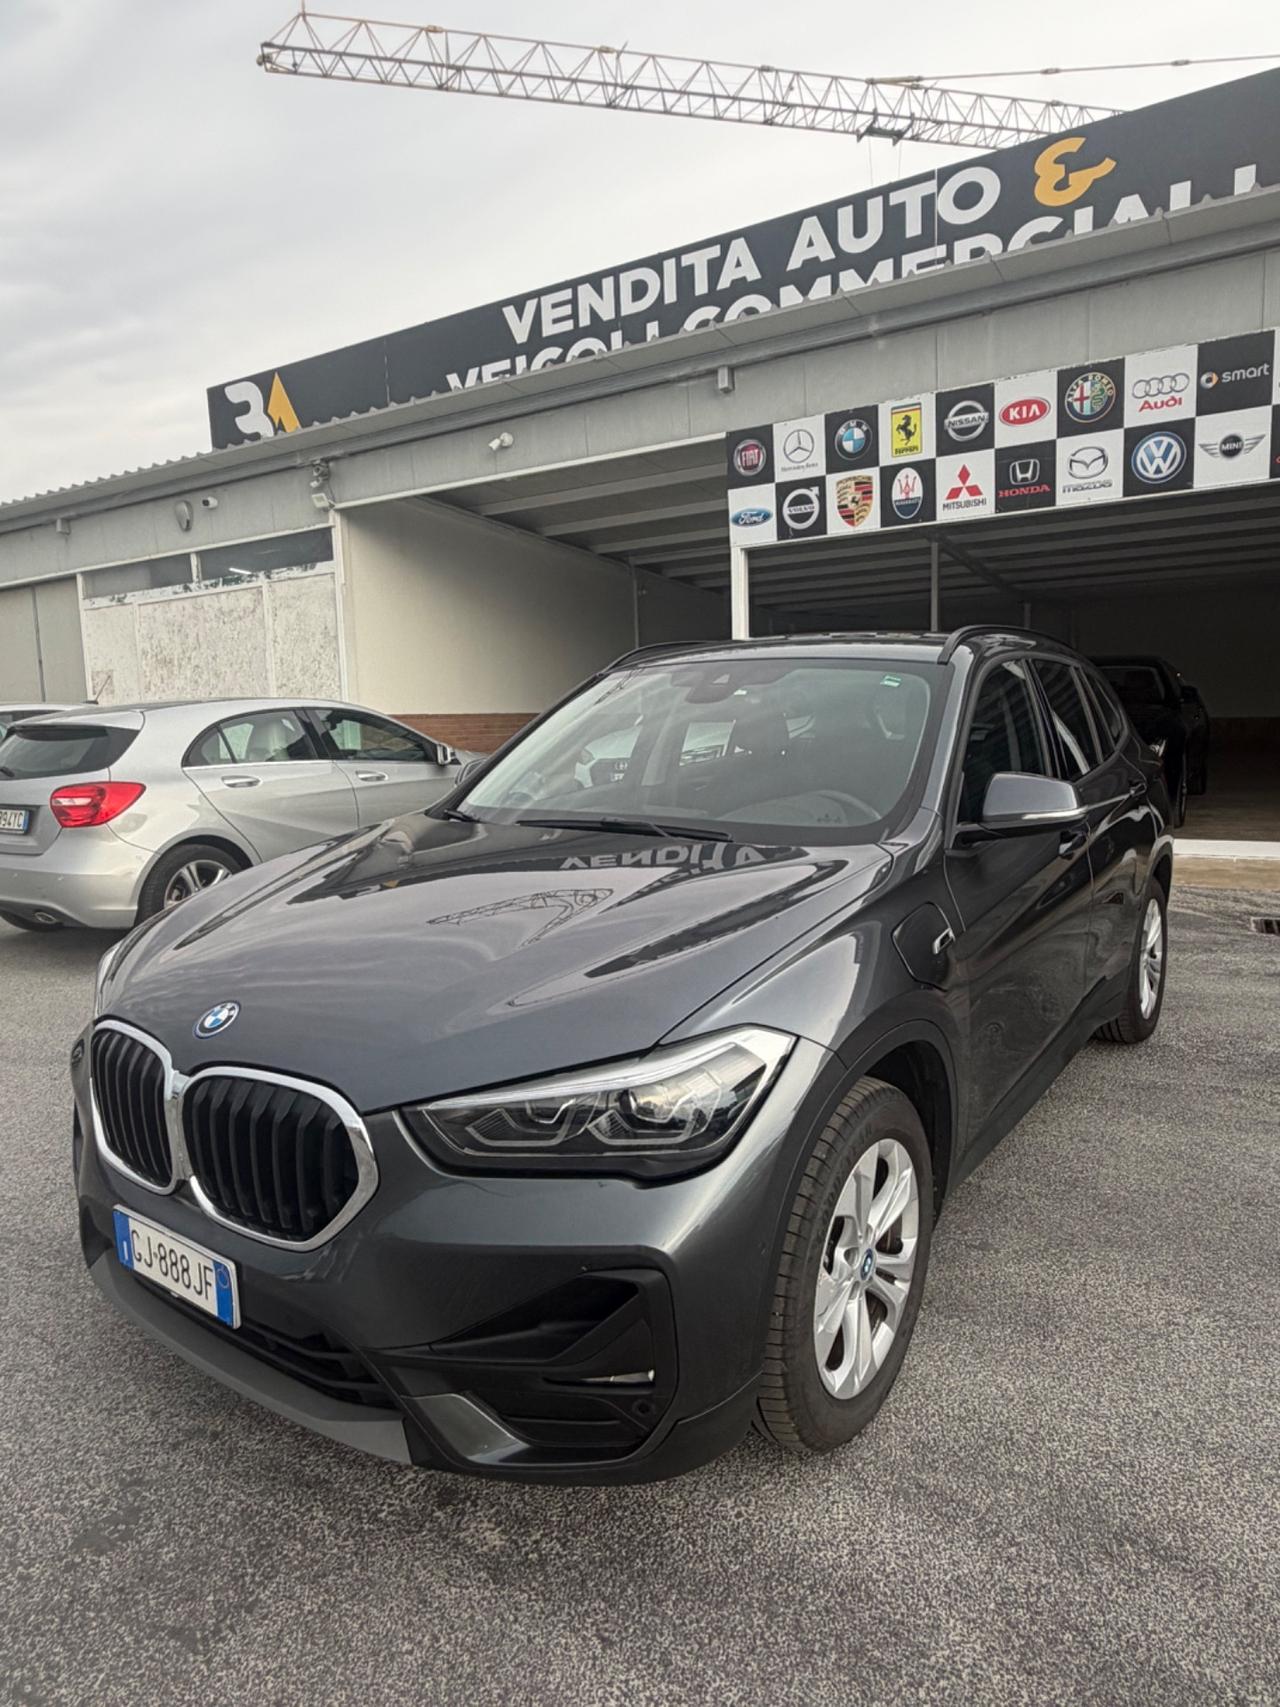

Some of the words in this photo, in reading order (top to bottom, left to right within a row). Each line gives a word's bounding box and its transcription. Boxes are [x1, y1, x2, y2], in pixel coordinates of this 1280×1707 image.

[502, 237, 761, 345] VENDITA
[786, 166, 1001, 272] AUTO
[1034, 136, 1117, 207] &
[1221, 362, 1270, 384] smart
[1138, 397, 1183, 412] Audi
[1008, 404, 1041, 421] KIA
[948, 414, 986, 428] NISSAN
[1221, 441, 1243, 452] MINI
[741, 448, 759, 467] FIAT
[997, 484, 1051, 498] HONDA
[942, 498, 987, 512] MITSUBISHI
[738, 510, 765, 525] Ford
